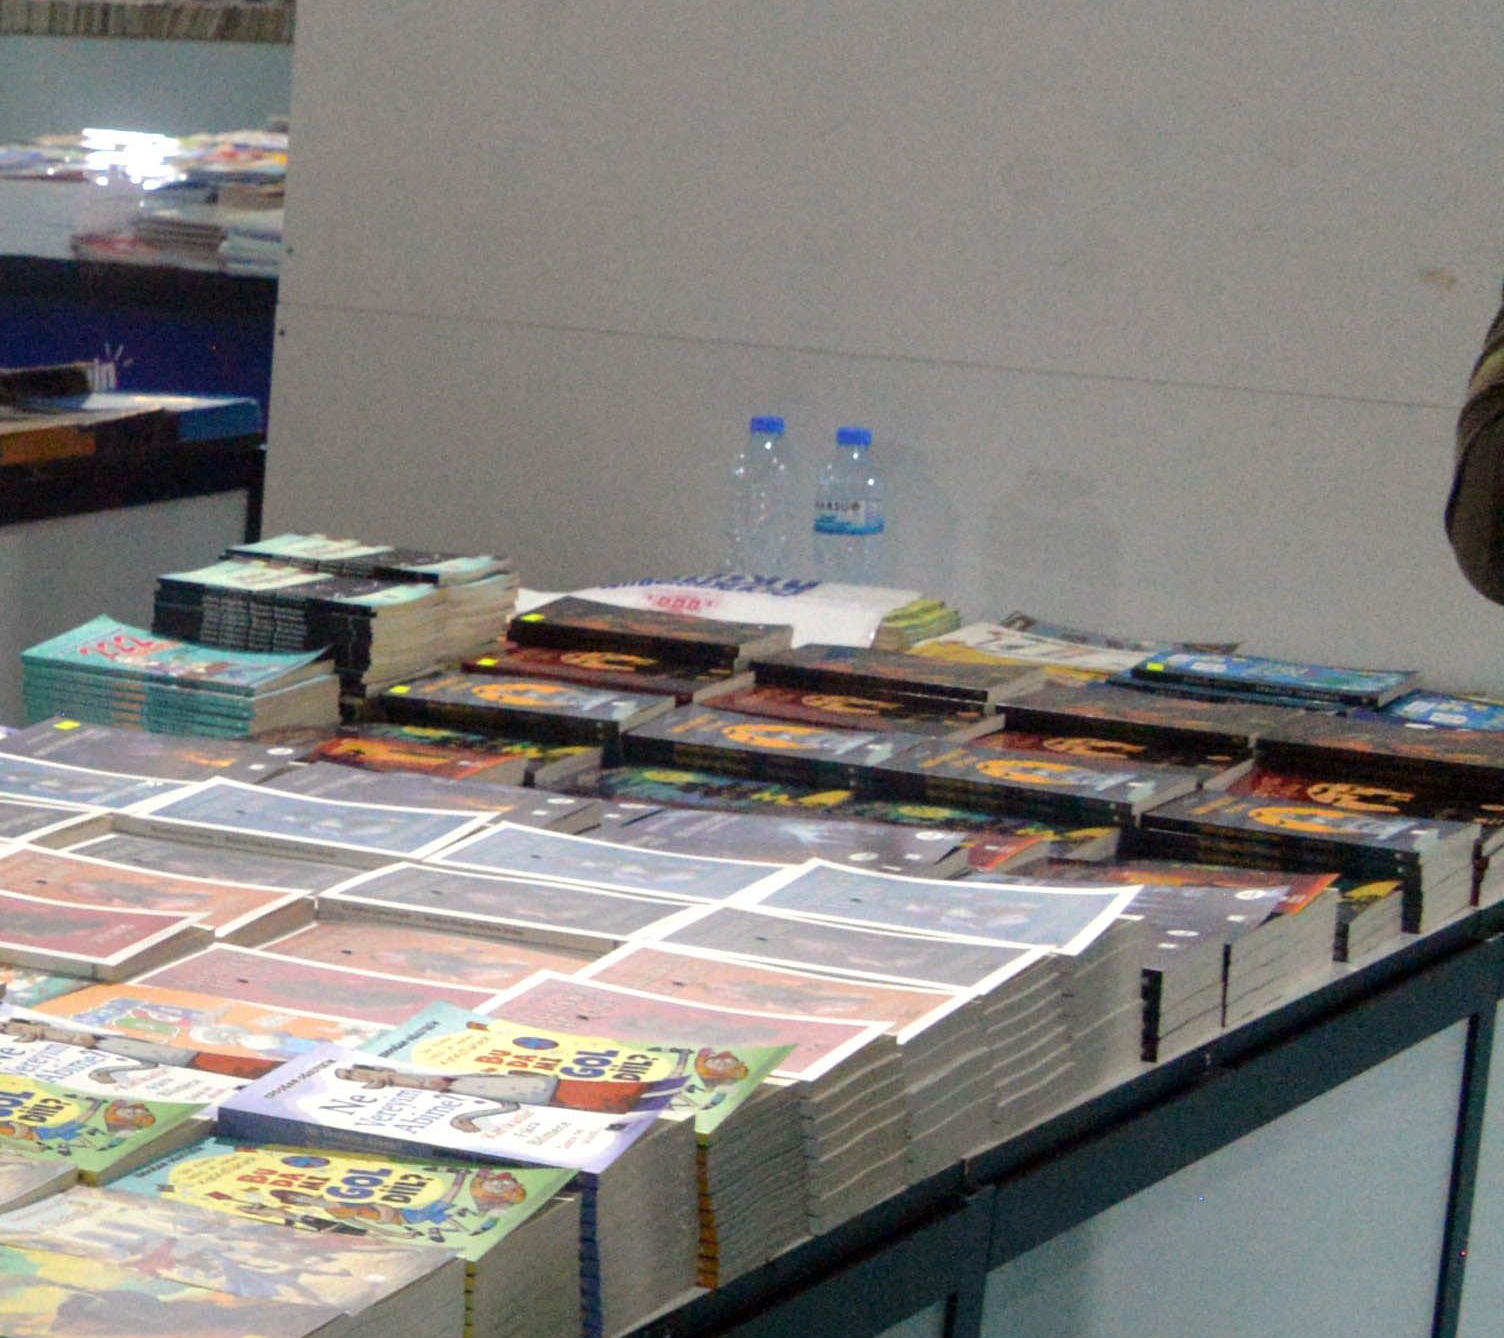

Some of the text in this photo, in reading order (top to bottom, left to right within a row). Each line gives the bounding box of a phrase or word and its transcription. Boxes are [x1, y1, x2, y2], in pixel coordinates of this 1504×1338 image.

[560, 1048, 622, 1079] GOL
[319, 1092, 380, 1118] Ne
[325, 1167, 394, 1200] GOL
